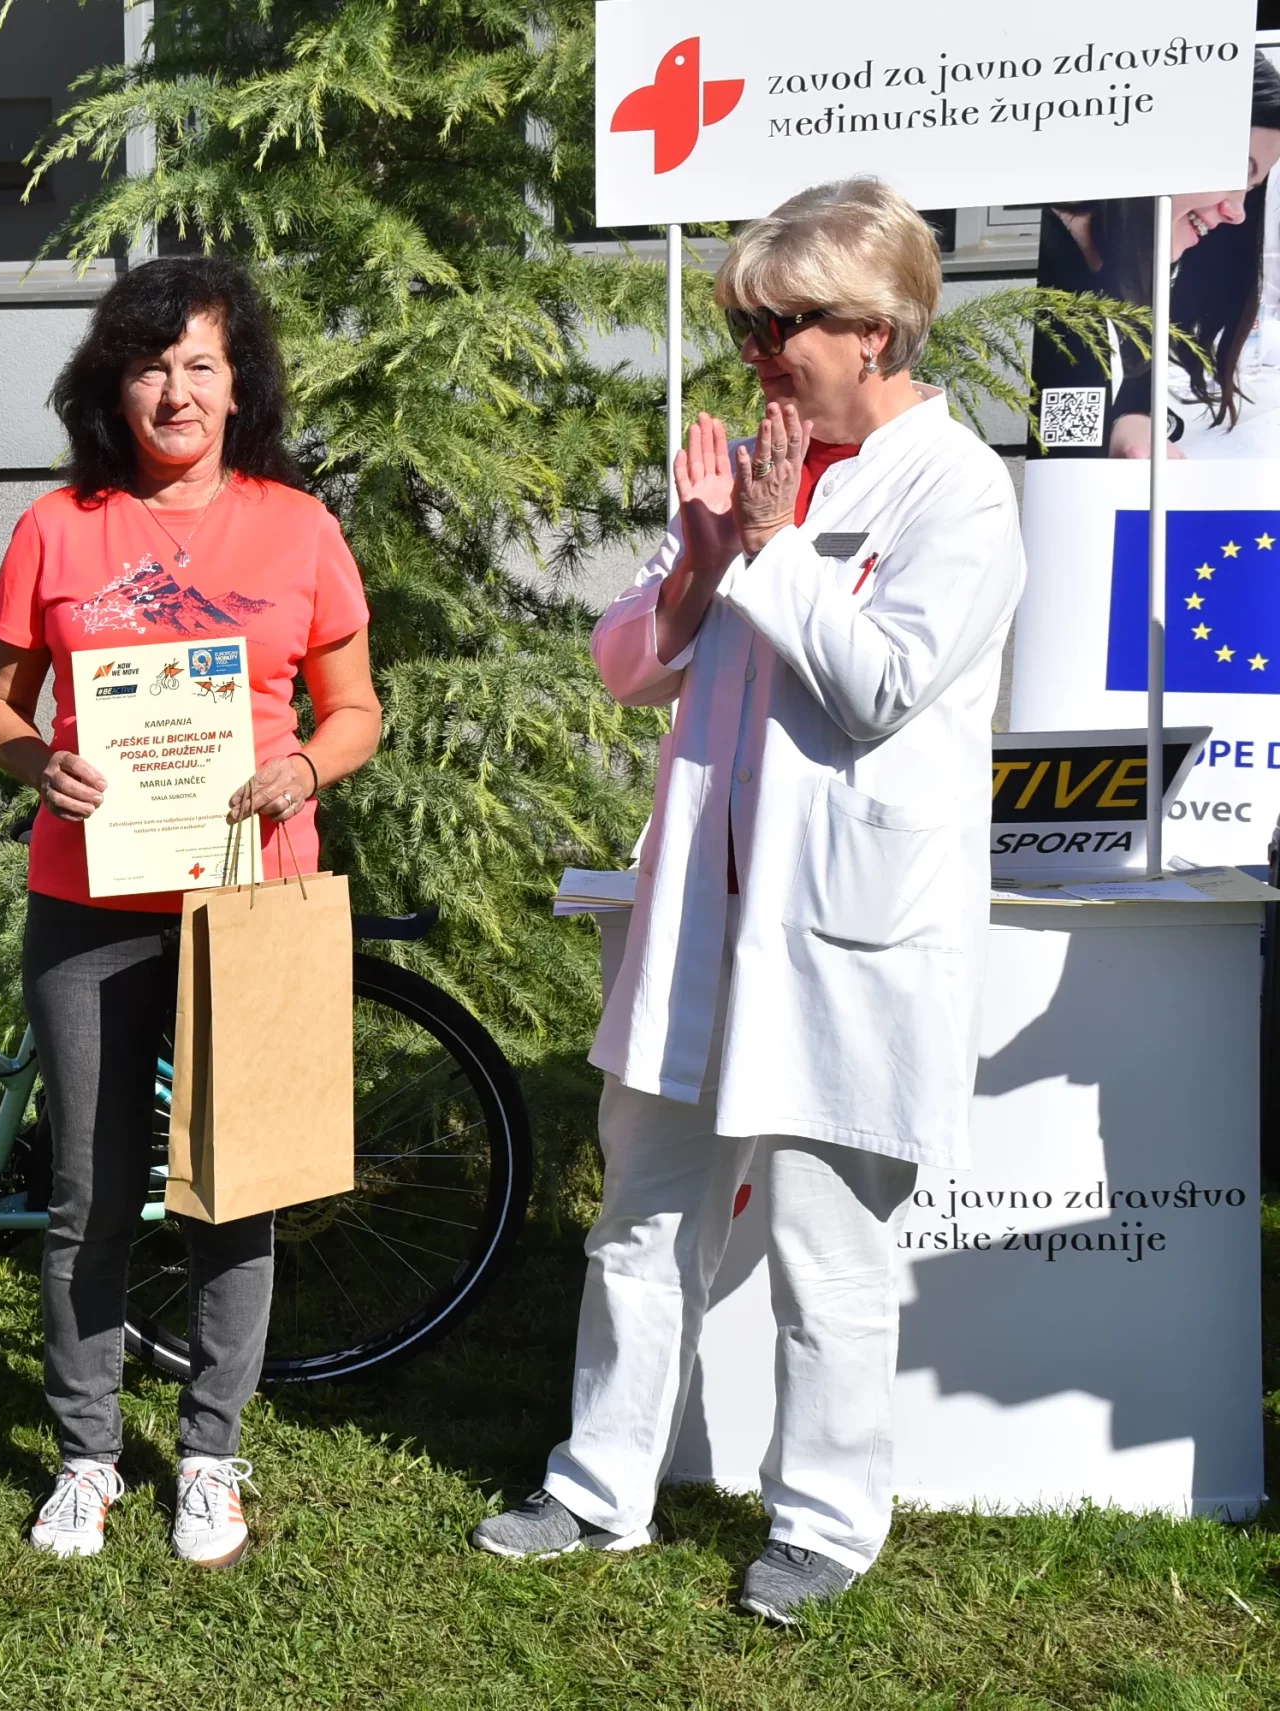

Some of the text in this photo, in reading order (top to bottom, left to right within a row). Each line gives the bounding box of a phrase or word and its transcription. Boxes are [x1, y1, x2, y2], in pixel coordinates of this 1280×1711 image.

[883, 65, 927, 87] za
[930, 52, 1042, 96] javno
[1052, 36, 1239, 75] zdravstvo
[767, 82, 1154, 138] Međimurske županije
[122, 668, 140, 676] MOVE
[98, 685, 137, 695] #BEACTIVE
[144, 718, 192, 728] KAMPANJA
[152, 735, 164, 745] ILI
[166, 732, 216, 743] BICIKLOM
[218, 730, 233, 739] NA
[120, 744, 221, 760] POSAO, DRUŽENJE I
[140, 776, 206, 789] MARIJA JANČEC
[169, 792, 197, 800] SUBOTICA
[991, 831, 1132, 854] SPORTA
[941, 1179, 1053, 1220] javno
[1065, 1180, 1246, 1209] zdravstvo
[1001, 1221, 1167, 1262] županije
